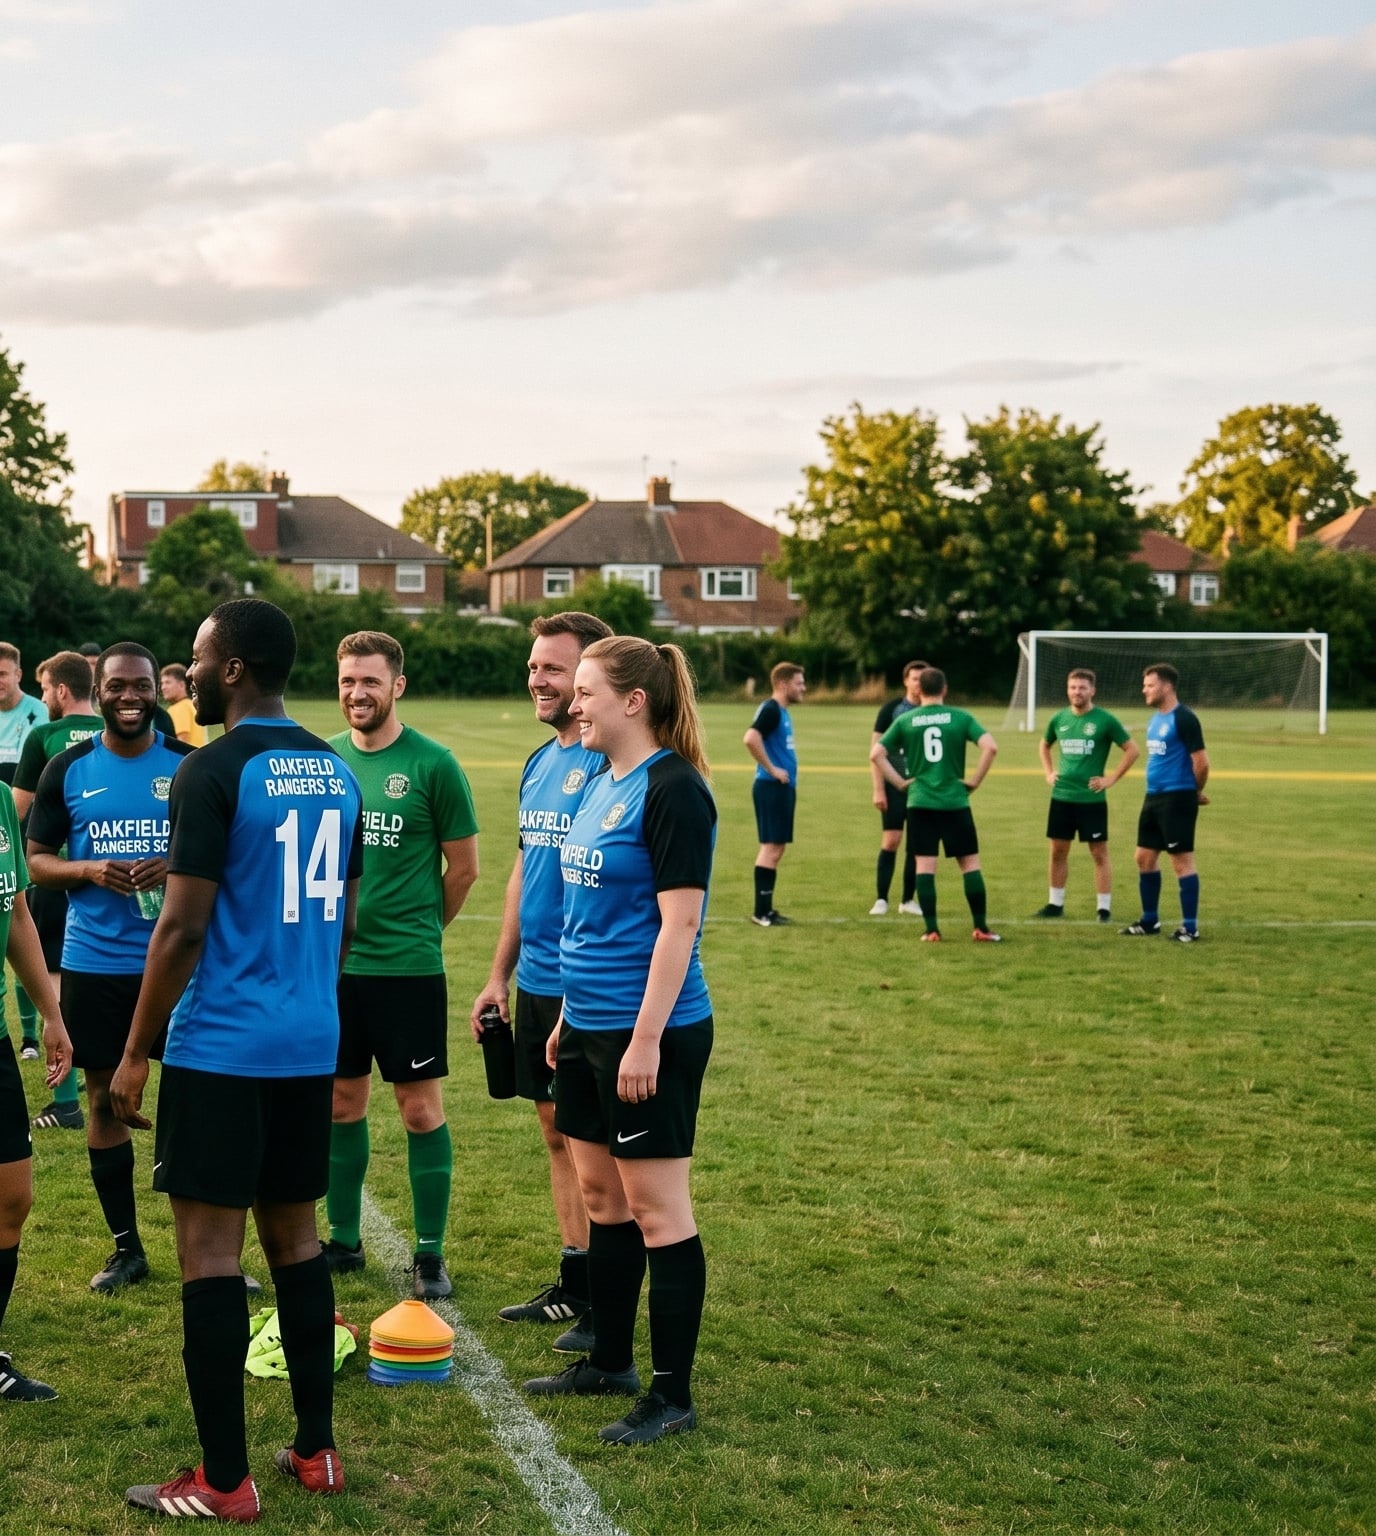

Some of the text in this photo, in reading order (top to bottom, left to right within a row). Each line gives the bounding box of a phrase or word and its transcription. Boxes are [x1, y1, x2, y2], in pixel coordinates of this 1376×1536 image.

[923, 726, 943, 763] 6
[269, 758, 335, 776] OAKFIELD
[265, 778, 346, 797] RANGERS SC
[89, 819, 171, 839] OAKFIELD
[362, 811, 403, 832] IELD
[519, 810, 571, 832] AKFIELD
[93, 839, 169, 854] RANGERS SC
[382, 834, 399, 847] SC
[275, 809, 344, 923] 14
